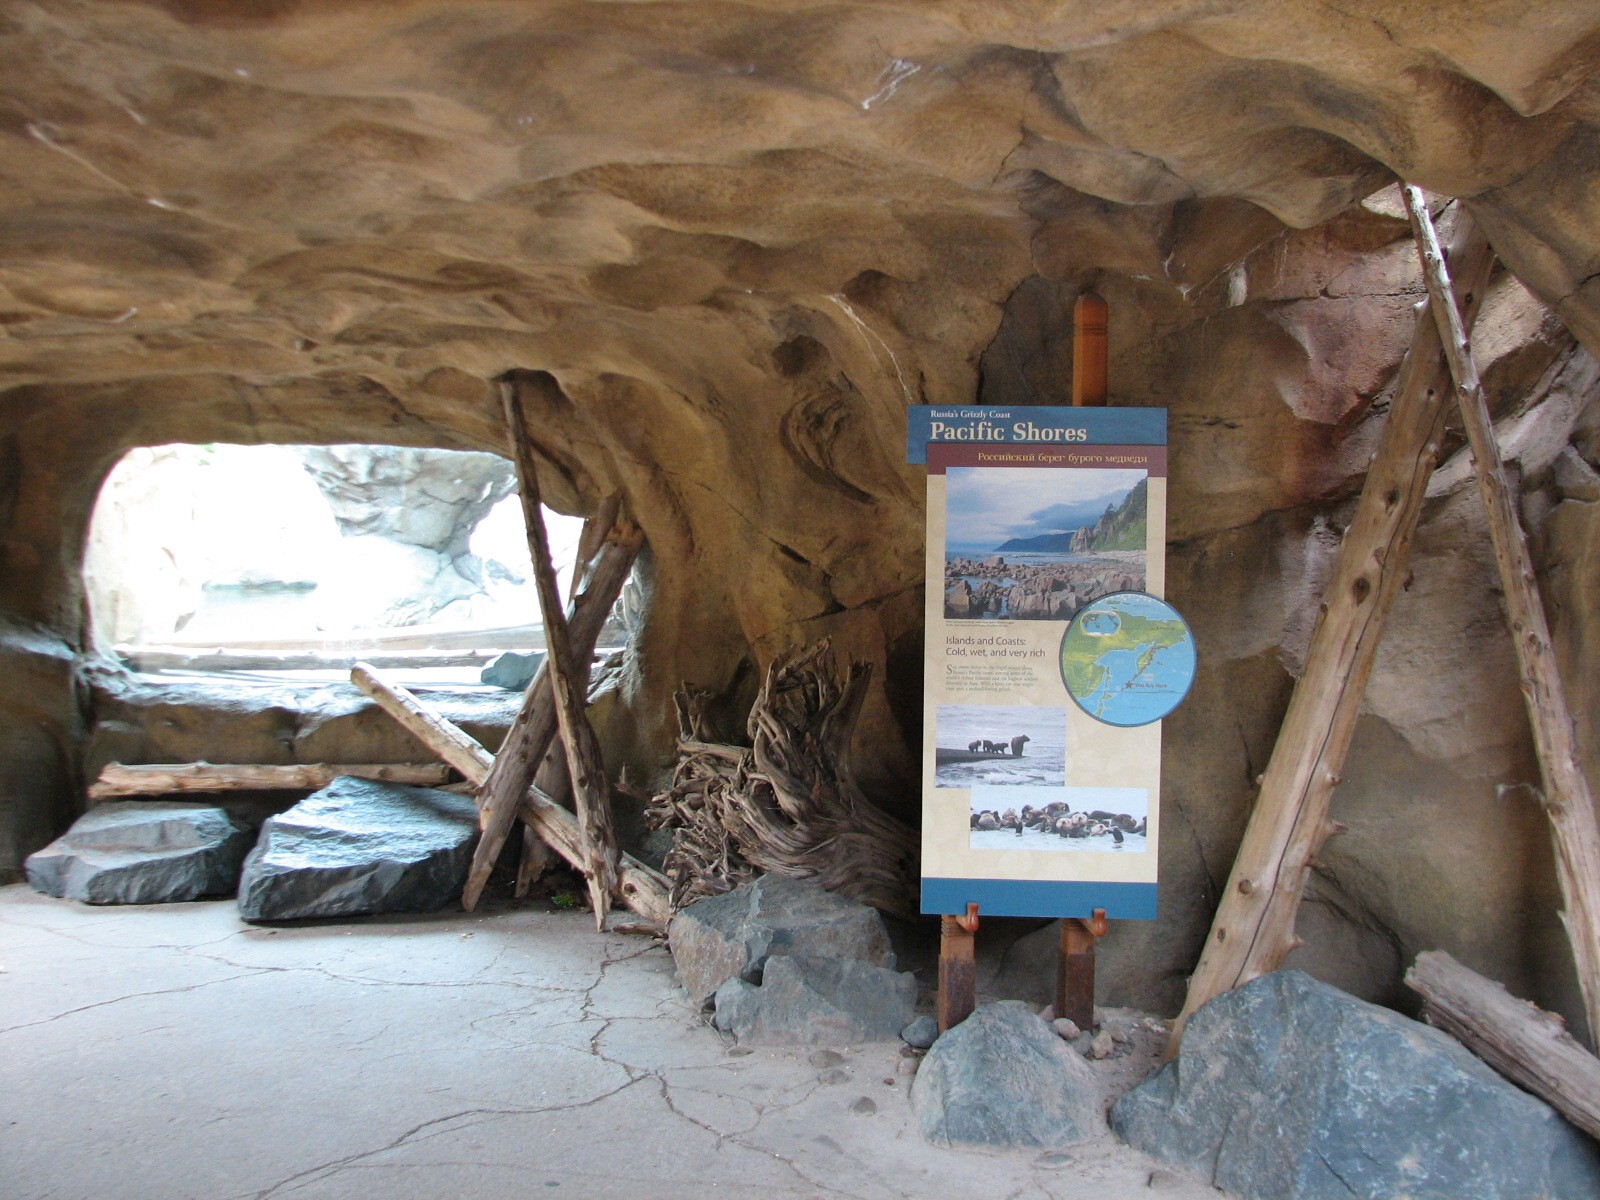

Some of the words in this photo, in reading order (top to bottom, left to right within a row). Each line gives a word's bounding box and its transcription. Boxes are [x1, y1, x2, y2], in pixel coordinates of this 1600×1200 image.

[930, 410, 958, 418] Russia's
[960, 410, 987, 420] Grizzly
[989, 410, 1011, 419] Coast
[930, 421, 1004, 441] Pacific
[1013, 422, 1087, 441] Shores
[978, 453, 1035, 462] Российский
[1038, 453, 1065, 464] берег
[1068, 453, 1102, 465] бурого
[1105, 455, 1148, 464] медведя
[946, 636, 975, 645] Islands
[977, 637, 994, 645] and
[996, 637, 1026, 646] Coasts:
[946, 647, 968, 657] Cold,
[970, 649, 988, 657] wet,
[990, 648, 1007, 657] and
[1009, 650, 1028, 658] very
[1030, 649, 1046, 657] rich
